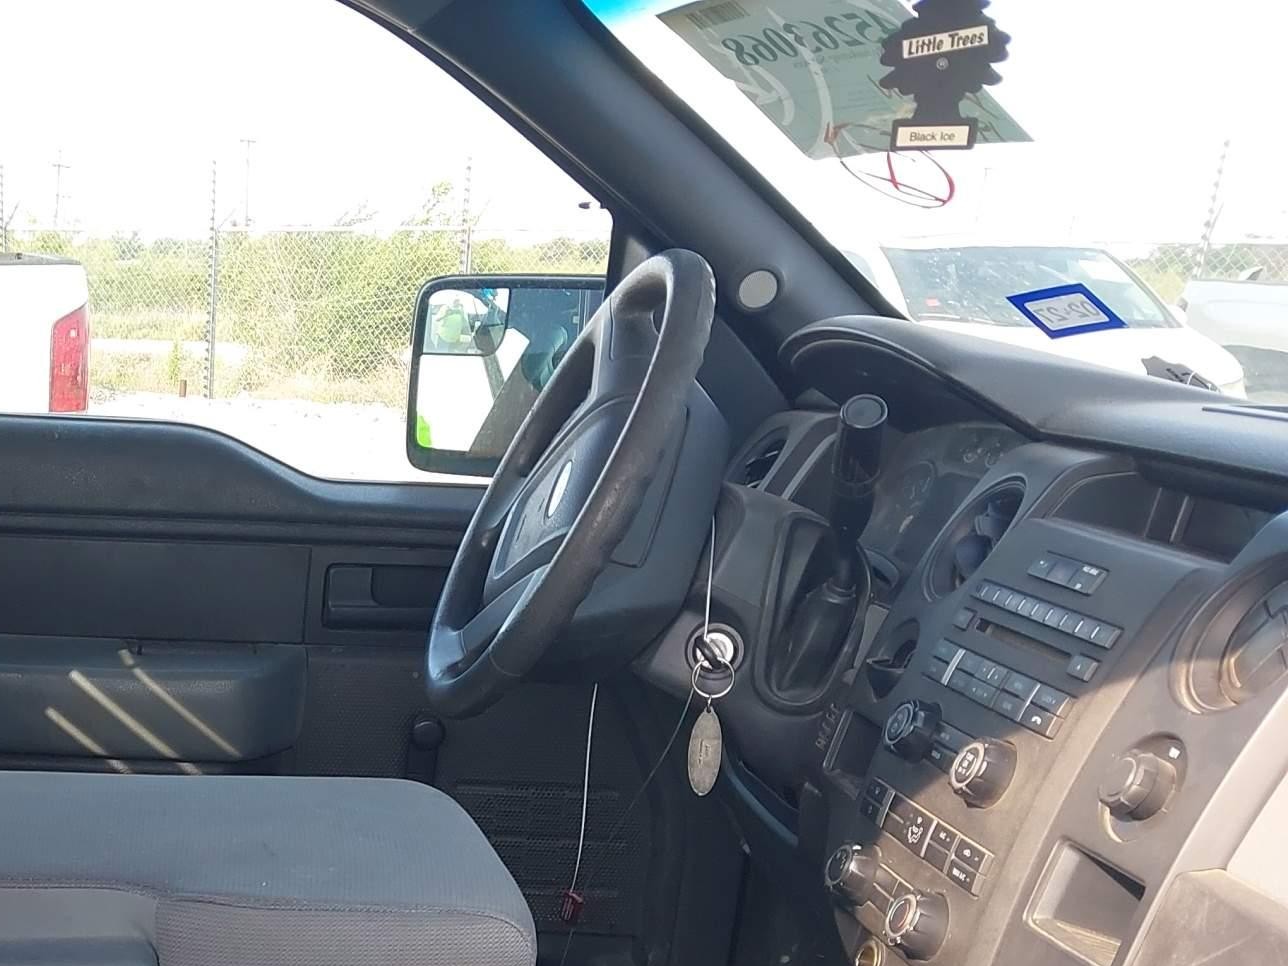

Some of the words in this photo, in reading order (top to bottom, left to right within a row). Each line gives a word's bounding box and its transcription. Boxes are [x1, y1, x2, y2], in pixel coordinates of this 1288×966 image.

[907, 36, 943, 56] Little
[947, 31, 985, 49] Trees
[909, 131, 937, 142] Black
[940, 131, 956, 141] Ice
